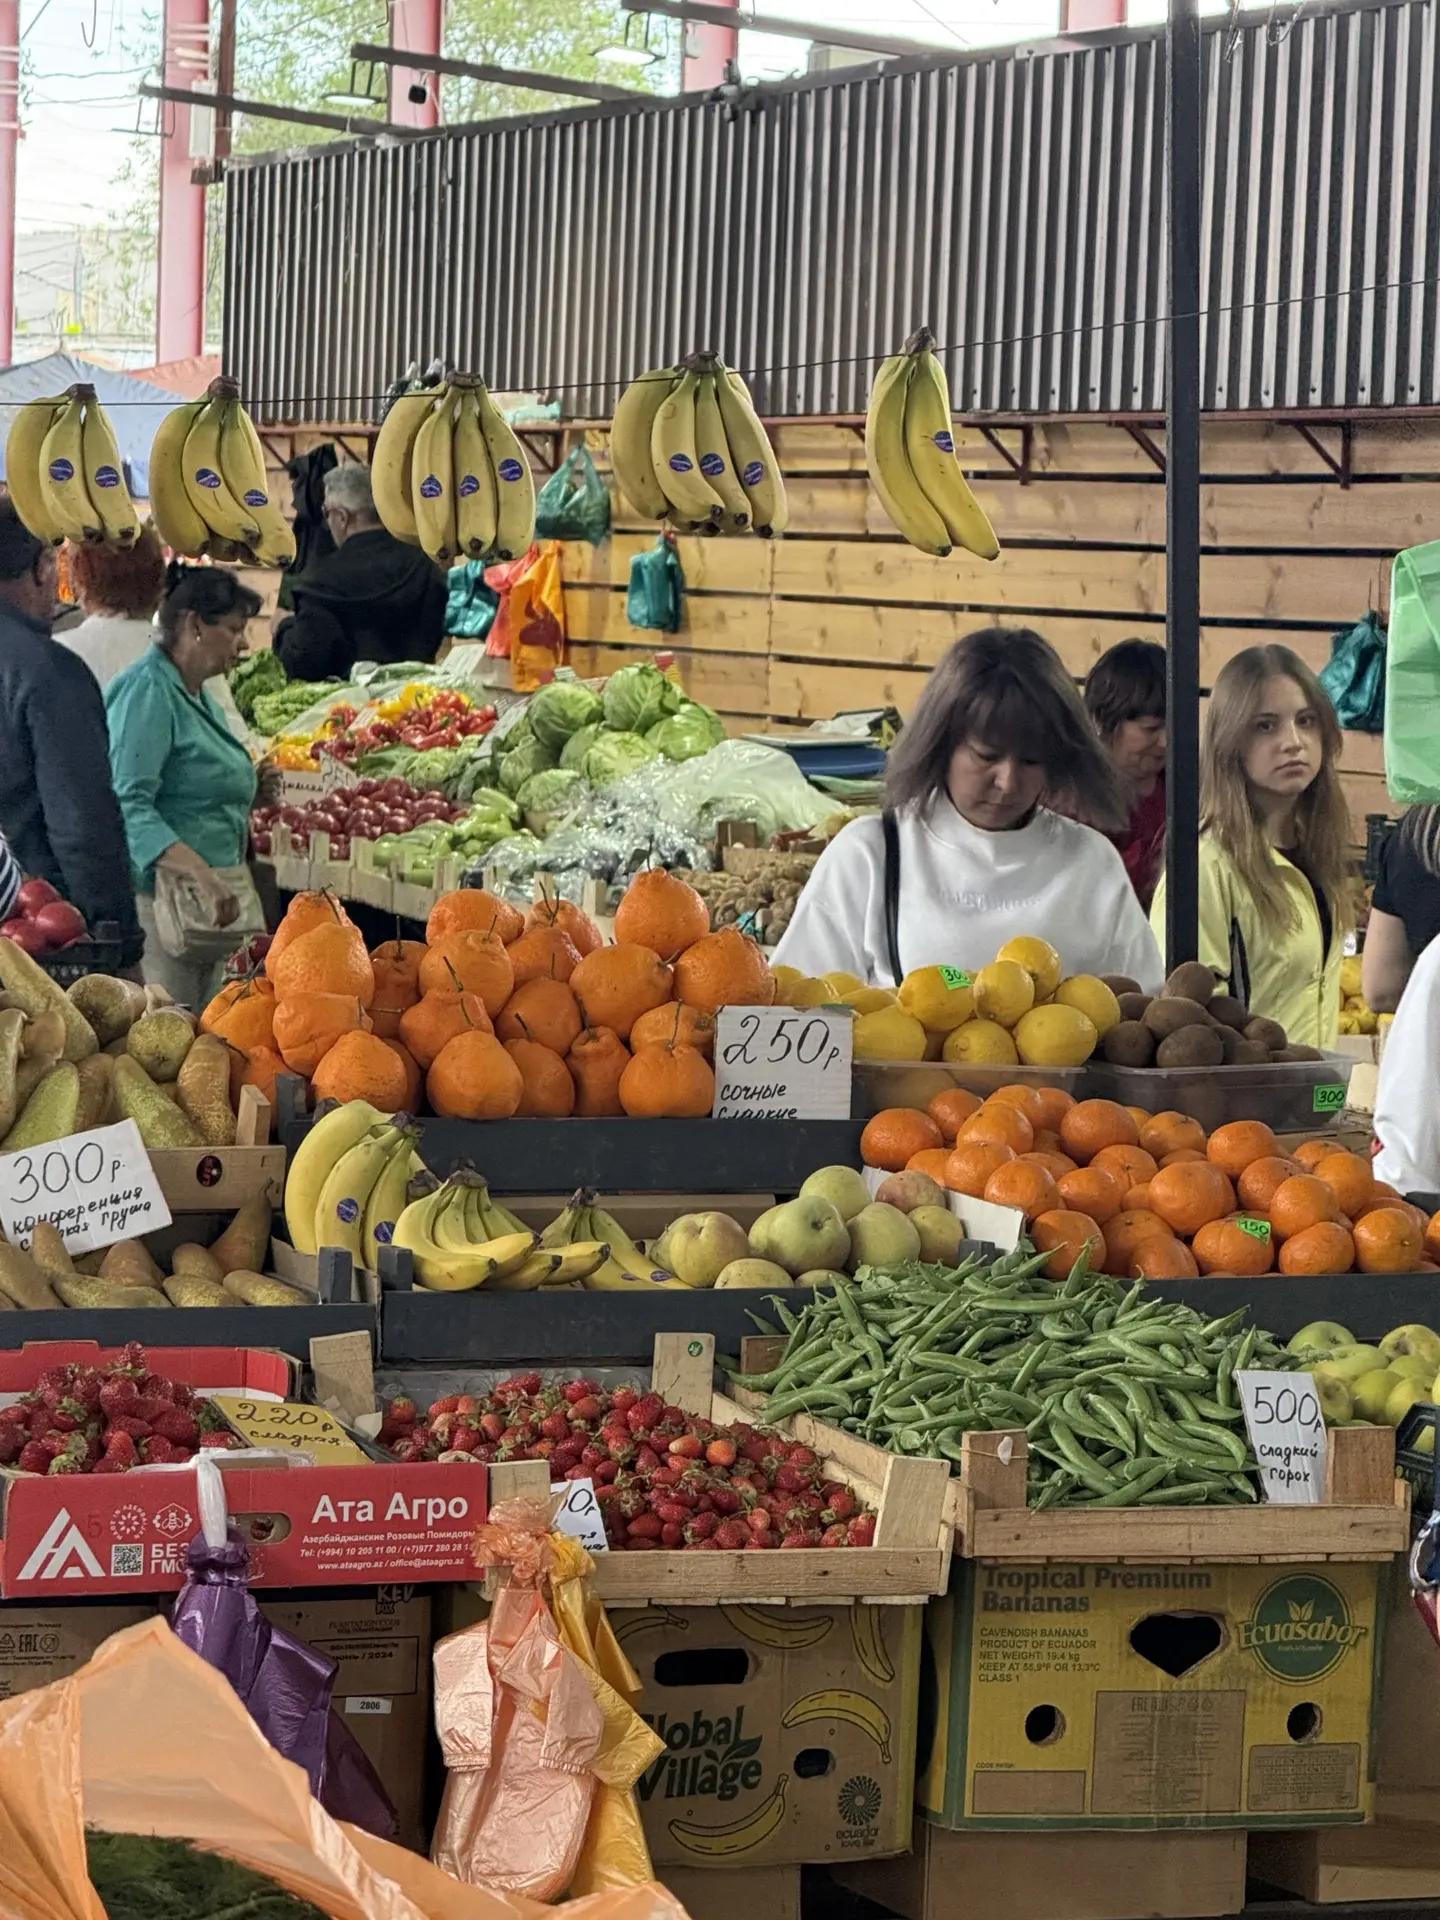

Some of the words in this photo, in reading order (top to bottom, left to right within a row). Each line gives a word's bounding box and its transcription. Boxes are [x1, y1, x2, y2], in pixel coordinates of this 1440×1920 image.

[1318, 1090, 1345, 1103] 300
[101, 1201, 152, 1232] груша
[1270, 1467, 1311, 1488] горох
[311, 1494, 374, 1523] Ата
[384, 1491, 468, 1527] Агро
[302, 1534, 385, 1545] Азербайджанские
[386, 1532, 425, 1541] Розовые
[300, 1549, 315, 1557] Tel:
[345, 1548, 355, 1556] 10
[358, 1547, 373, 1555] 205
[375, 1546, 384, 1554] 11
[385, 1546, 397, 1554] 00
[435, 1543, 450, 1552] 280
[451, 1543, 462, 1551] 28
[317, 1561, 384, 1571] www.ataagro.az
[389, 1557, 465, 1568] office@ataagro.az
[982, 1565, 1085, 1594] Tropical
[1094, 1565, 1211, 1588] Premium
[982, 1589, 1090, 1612] Bananas
[980, 1628, 1037, 1638] CAVENDISH
[1040, 1628, 1089, 1638] BANANAS
[1236, 1614, 1368, 1650] Ecuasabor
[979, 1640, 1029, 1649] PRODUCT
[1031, 1640, 1045, 1649] OF
[1047, 1640, 1097, 1649] ECUADOR
[368, 1651, 394, 1659] 2024
[979, 1651, 1000, 1660] NET
[1002, 1651, 1044, 1660] WEIGHT:
[1068, 1651, 1080, 1662] kg
[978, 1663, 1005, 1671] KEEP
[1008, 1663, 1020, 1671] AT
[1054, 1663, 1068, 1671] OR
[978, 1674, 1013, 1682] CLASS
[1015, 1674, 1020, 1682] 1
[360, 1701, 381, 1710] 2806
[637, 1755, 763, 1801] Village
